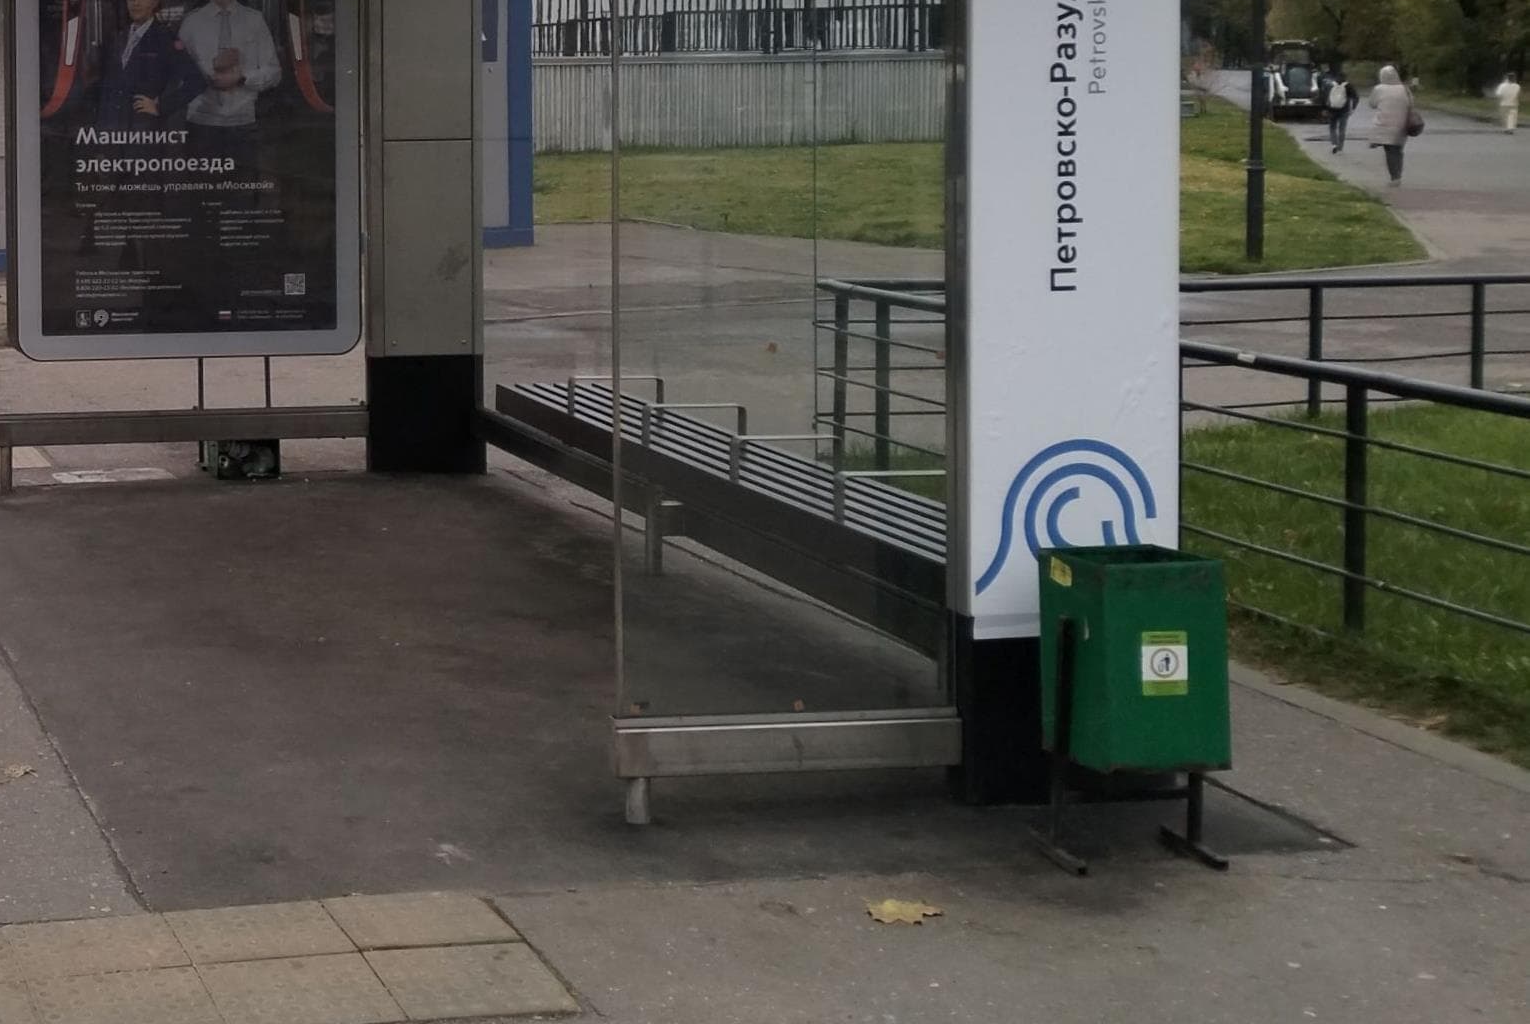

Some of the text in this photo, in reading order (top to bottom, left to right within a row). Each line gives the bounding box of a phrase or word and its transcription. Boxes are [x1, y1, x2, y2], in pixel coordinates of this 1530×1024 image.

[75, 127, 189, 145] Машинист
[75, 157, 236, 176] электропоезда
[75, 182, 89, 193] Ты
[91, 183, 117, 192] тоже
[119, 182, 162, 192] можешь
[163, 183, 214, 193] управлять
